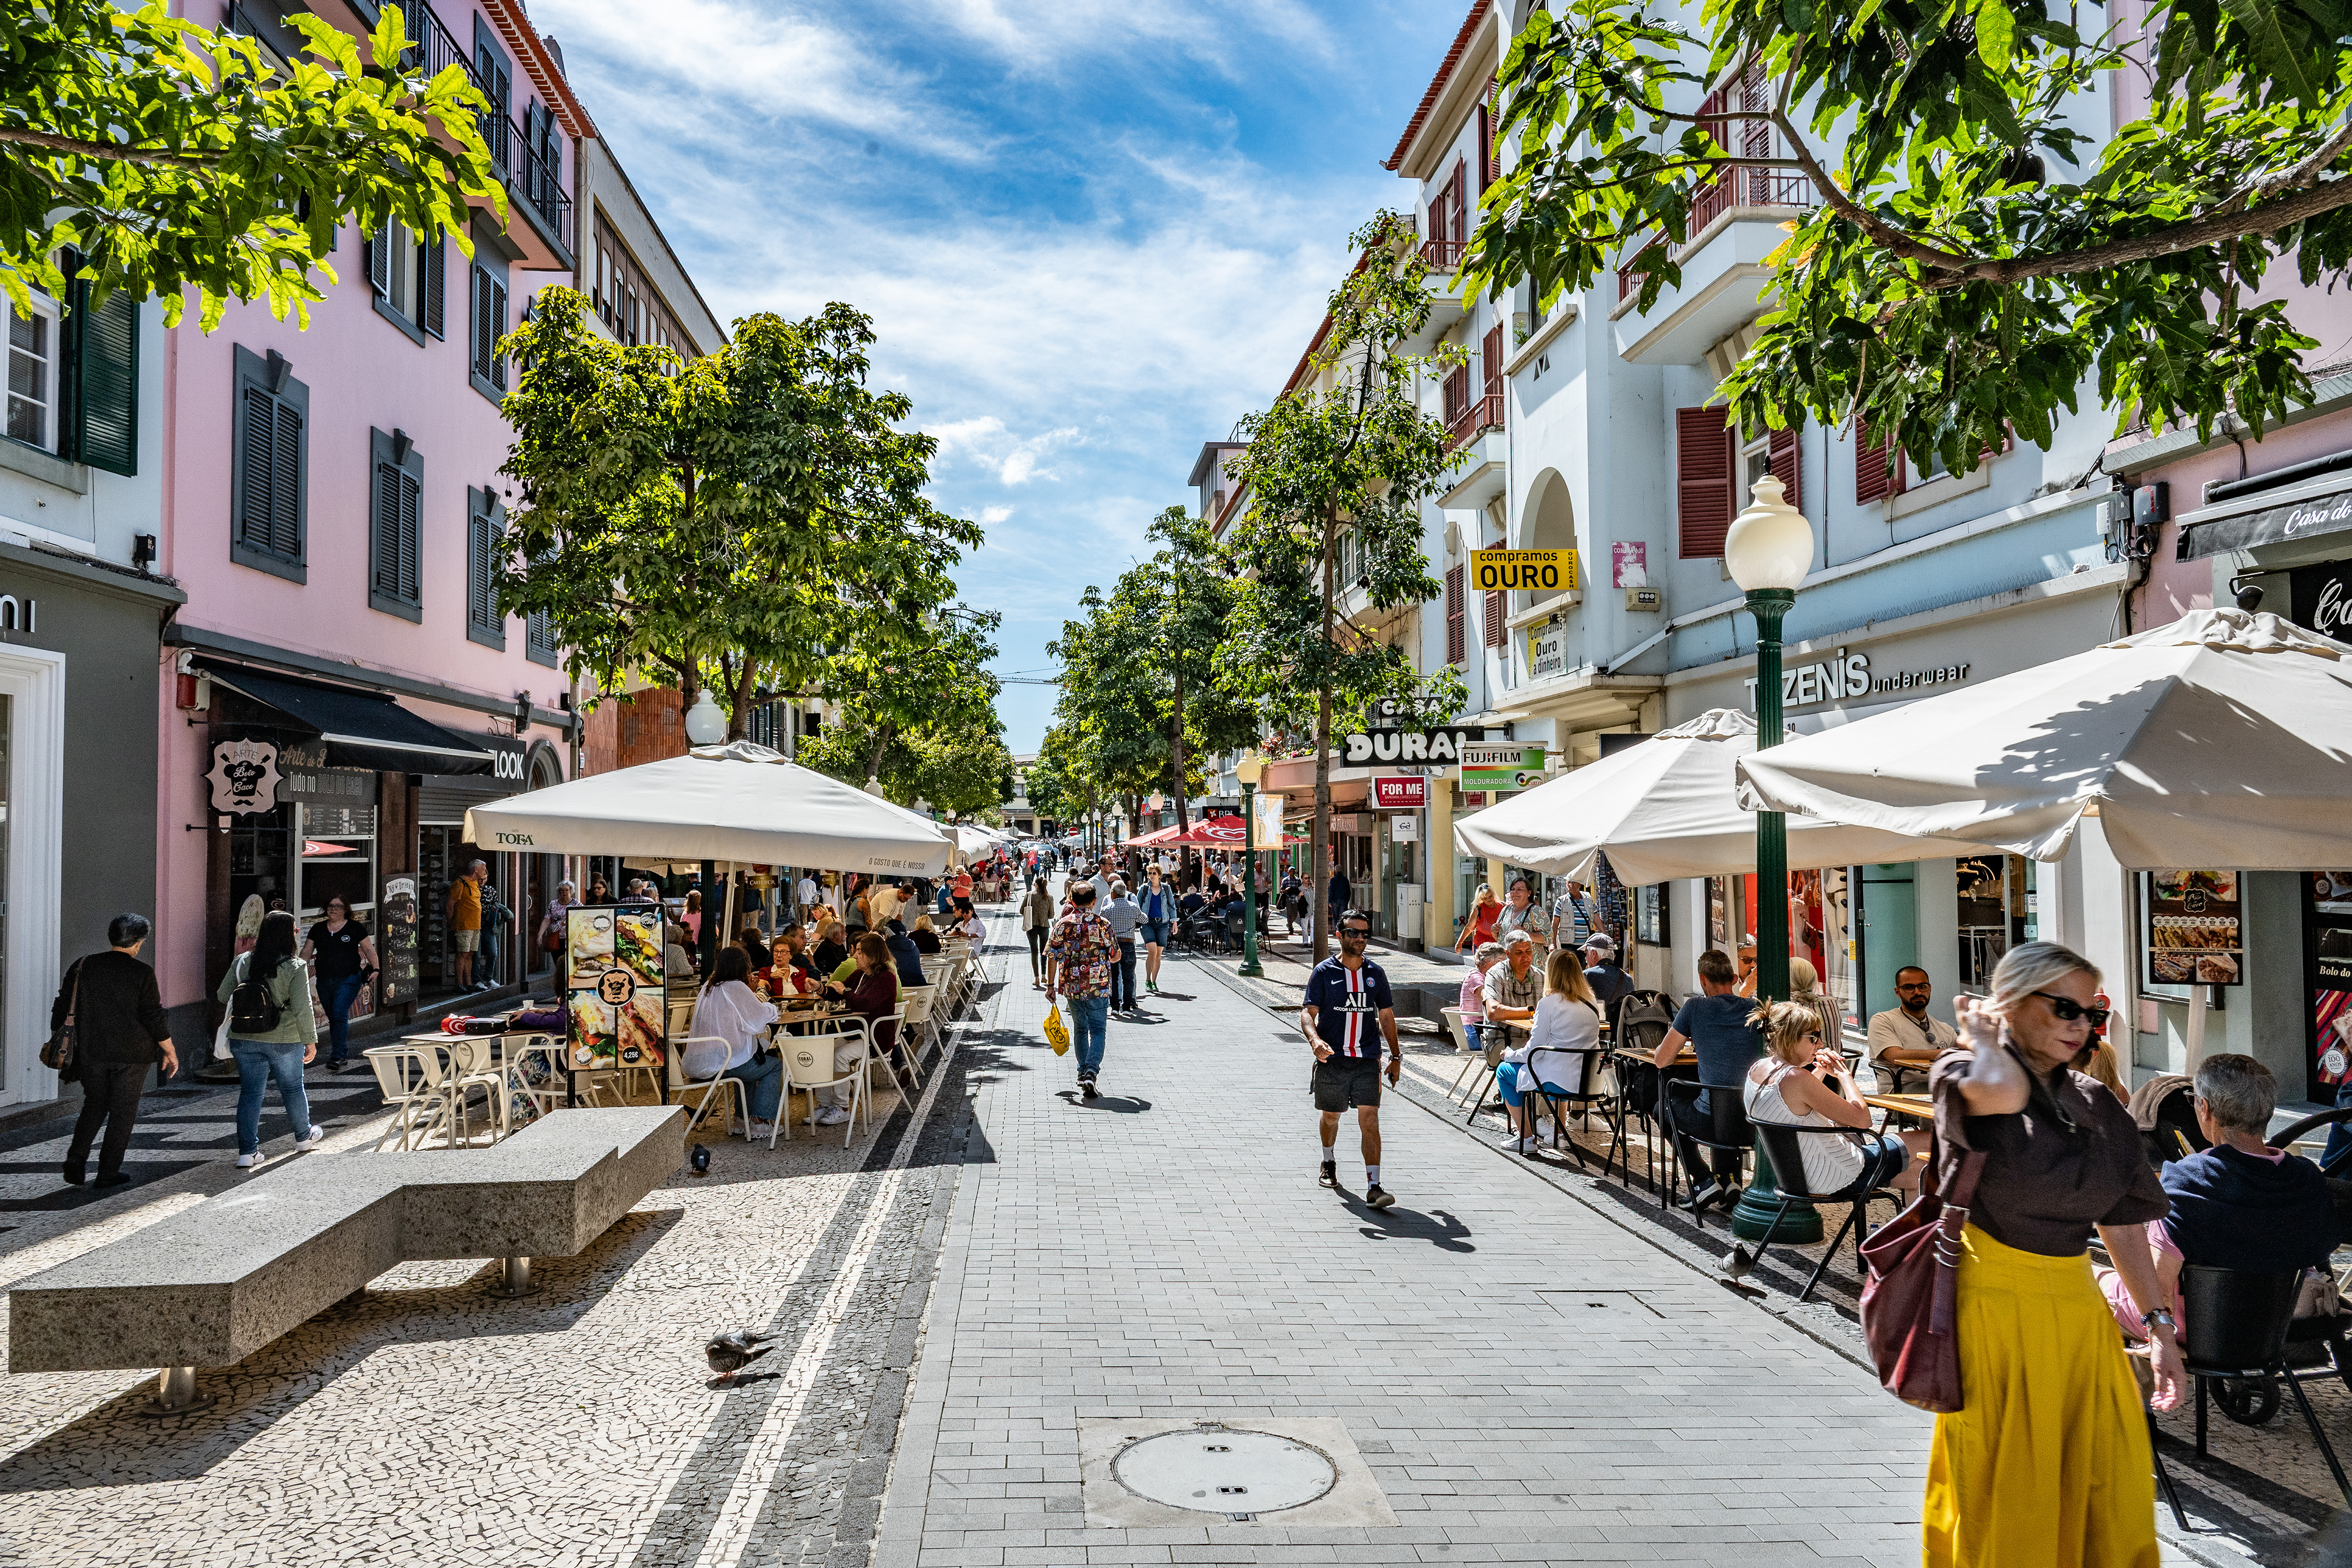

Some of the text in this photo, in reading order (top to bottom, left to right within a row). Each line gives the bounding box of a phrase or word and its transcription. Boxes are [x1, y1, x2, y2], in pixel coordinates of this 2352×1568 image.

[2284, 509, 2329, 535] Casa
[1480, 552, 1558, 564] compramos
[1480, 565, 1558, 588] OURO
[1536, 640, 1557, 657] Ouro
[1533, 654, 1561, 675] a dinheiro
[1873, 664, 1968, 692] underwear
[233, 750, 259, 760] ARTE
[279, 745, 306, 766] Arte
[1464, 752, 1520, 763] FUJIFILM
[233, 766, 256, 777] Bolo
[234, 782, 255, 792] Caco
[290, 772, 305, 792] Tudo
[307, 775, 316, 792] no
[1382, 783, 1422, 795] FOR ME
[496, 833, 534, 845] TOFA
[874, 858, 891, 866] GOSTO
[903, 860, 907, 868] É
[2320, 965, 2350, 977] Bolo do
